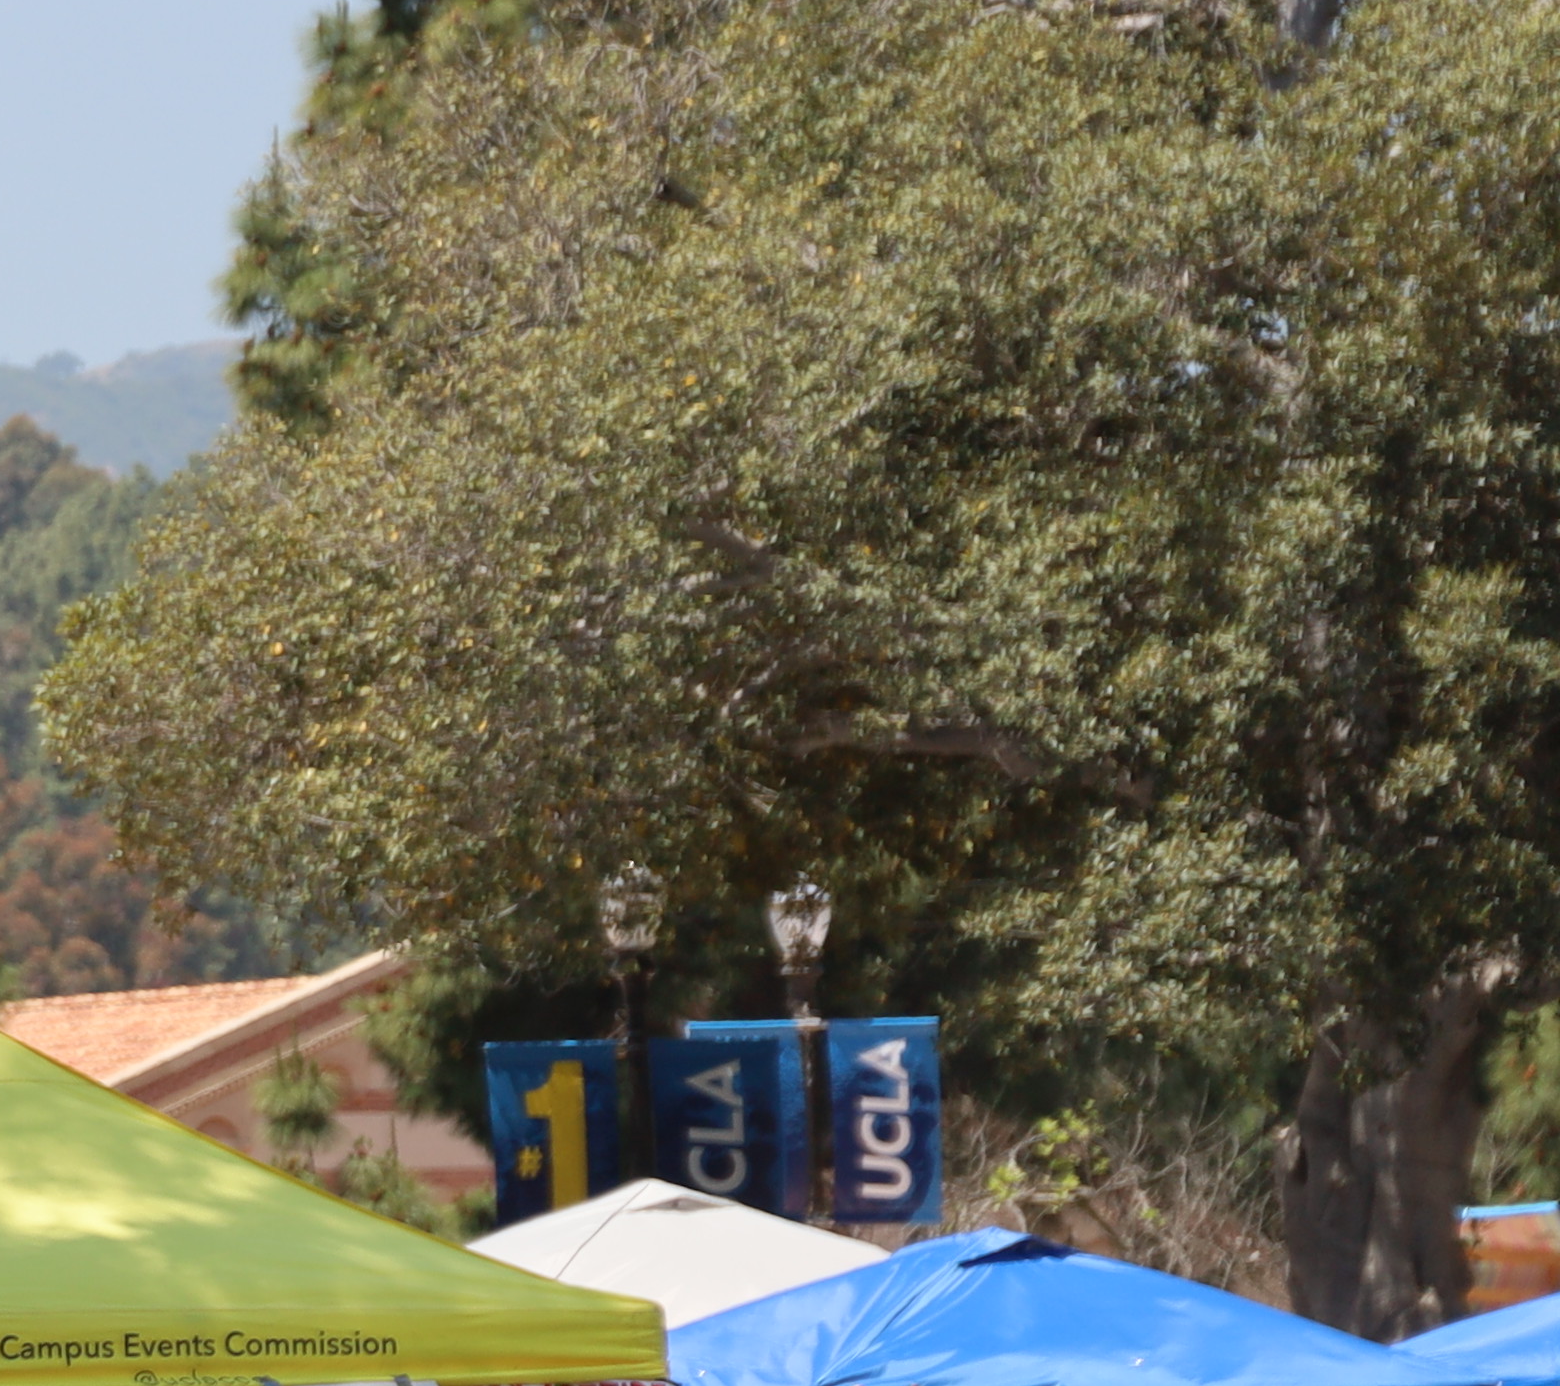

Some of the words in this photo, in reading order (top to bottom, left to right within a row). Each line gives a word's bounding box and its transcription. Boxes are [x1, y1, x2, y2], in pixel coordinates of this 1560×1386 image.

[686, 1058, 748, 1194] CLA
[858, 1037, 913, 1201] UCLA
[0, 1335, 114, 1366] Campus
[124, 1333, 216, 1357] Events
[225, 1331, 397, 1357] Commission
